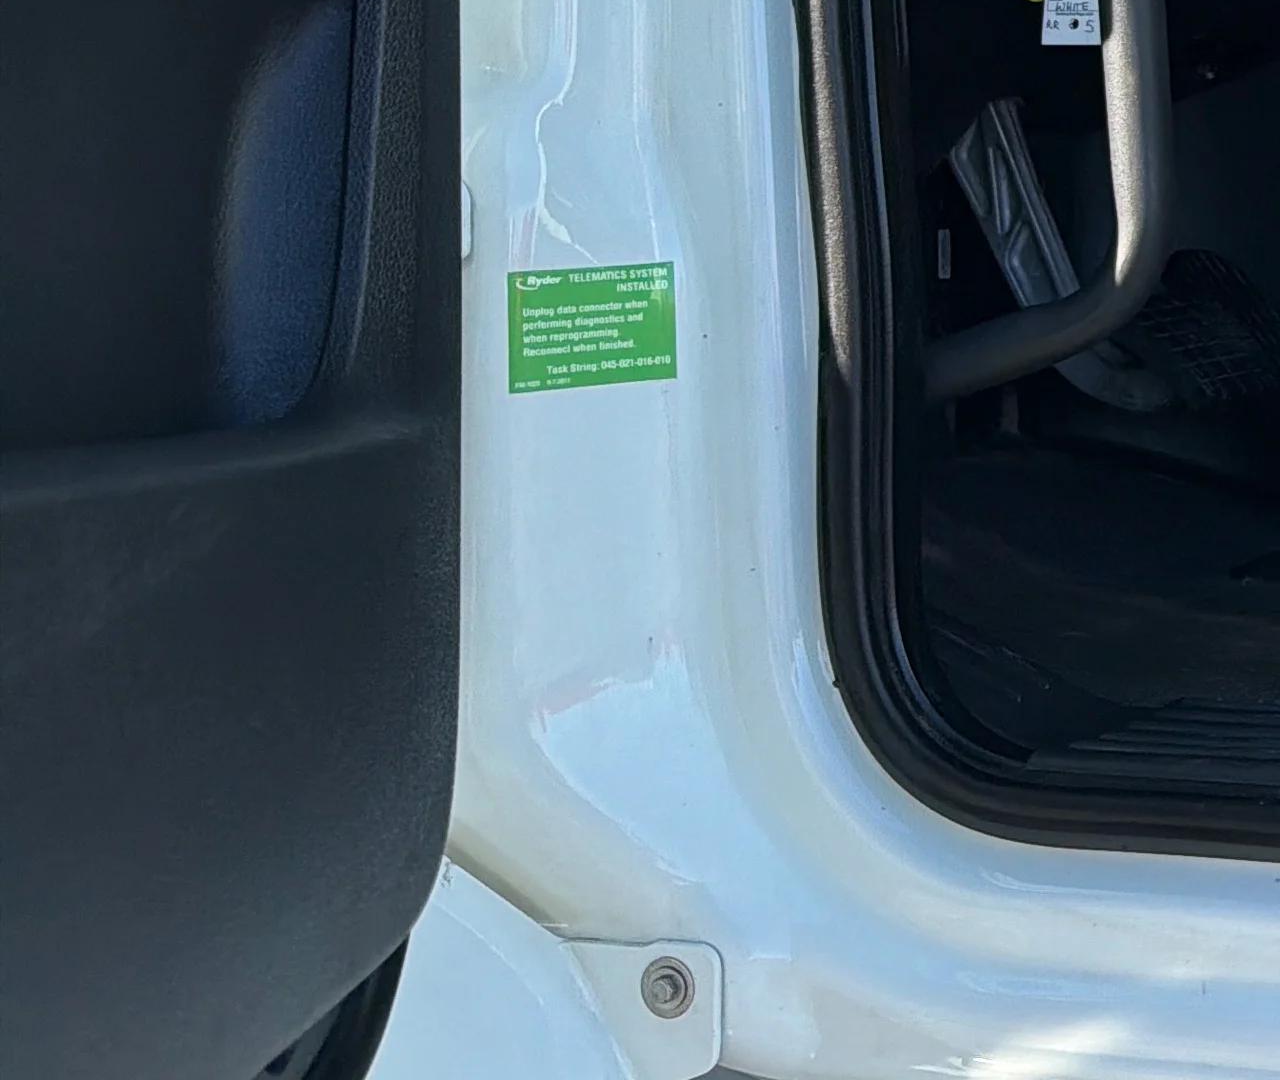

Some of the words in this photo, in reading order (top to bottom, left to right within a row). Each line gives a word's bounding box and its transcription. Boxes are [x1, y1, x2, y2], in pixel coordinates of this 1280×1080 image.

[1056, 1, 1089, 11] WHITE
[527, 275, 562, 287] Ryder
[569, 270, 627, 283] TELEMATICS
[630, 268, 668, 279] SYSTEM
[617, 280, 668, 292] INSTALLED
[523, 307, 554, 318] Unplug
[557, 305, 577, 314] data
[579, 302, 622, 313] connector
[625, 300, 648, 310] when
[523, 320, 572, 331] performing
[575, 316, 625, 326] diagnostics
[627, 313, 643, 321] and
[523, 334, 547, 344] when
[523, 344, 570, 357] Reconnect
[573, 342, 597, 352] when
[599, 340, 636, 350] finished.
[546, 365, 568, 375] Task
[570, 363, 600, 373] String:
